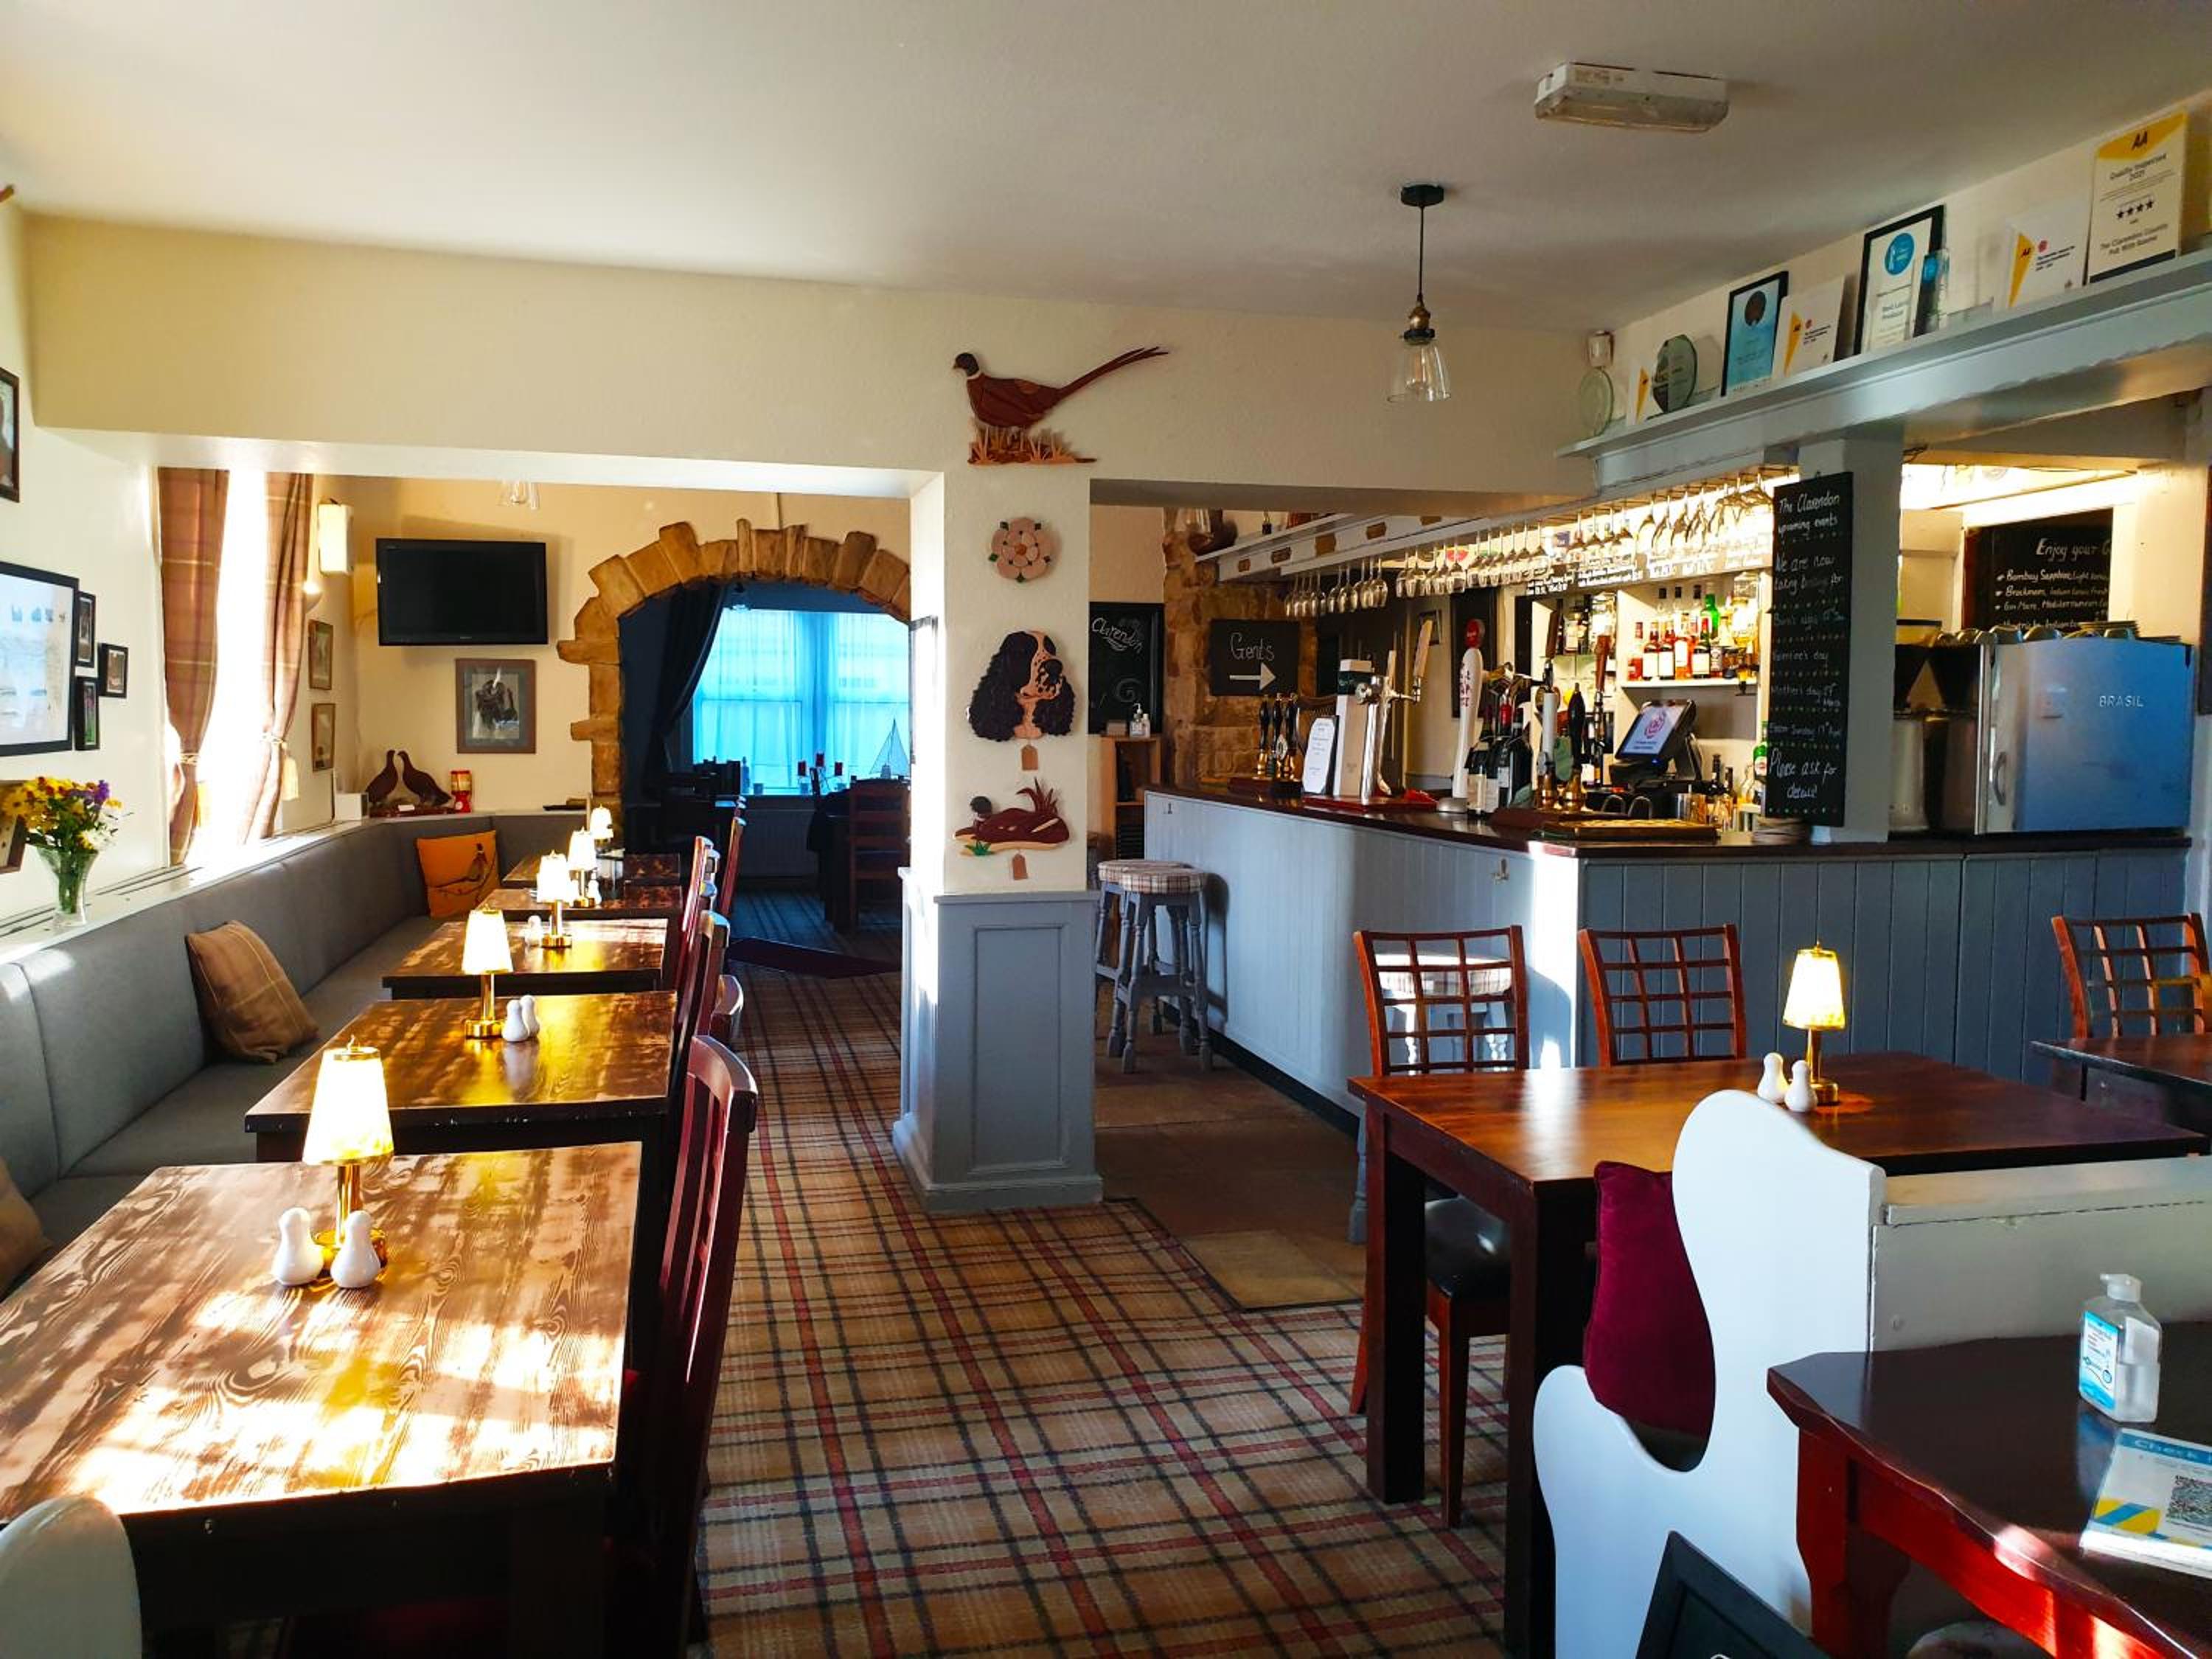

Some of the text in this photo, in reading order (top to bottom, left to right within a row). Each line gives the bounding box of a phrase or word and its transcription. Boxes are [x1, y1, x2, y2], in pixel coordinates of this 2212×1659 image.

[2036, 538, 2067, 562] Enjoy
[2072, 543, 2098, 561] your
[2006, 568, 2039, 583] Bombay
[1091, 616, 1144, 655] Clarendon
[1229, 631, 1276, 662] Gents
[2098, 695, 2145, 708] BRASIL
